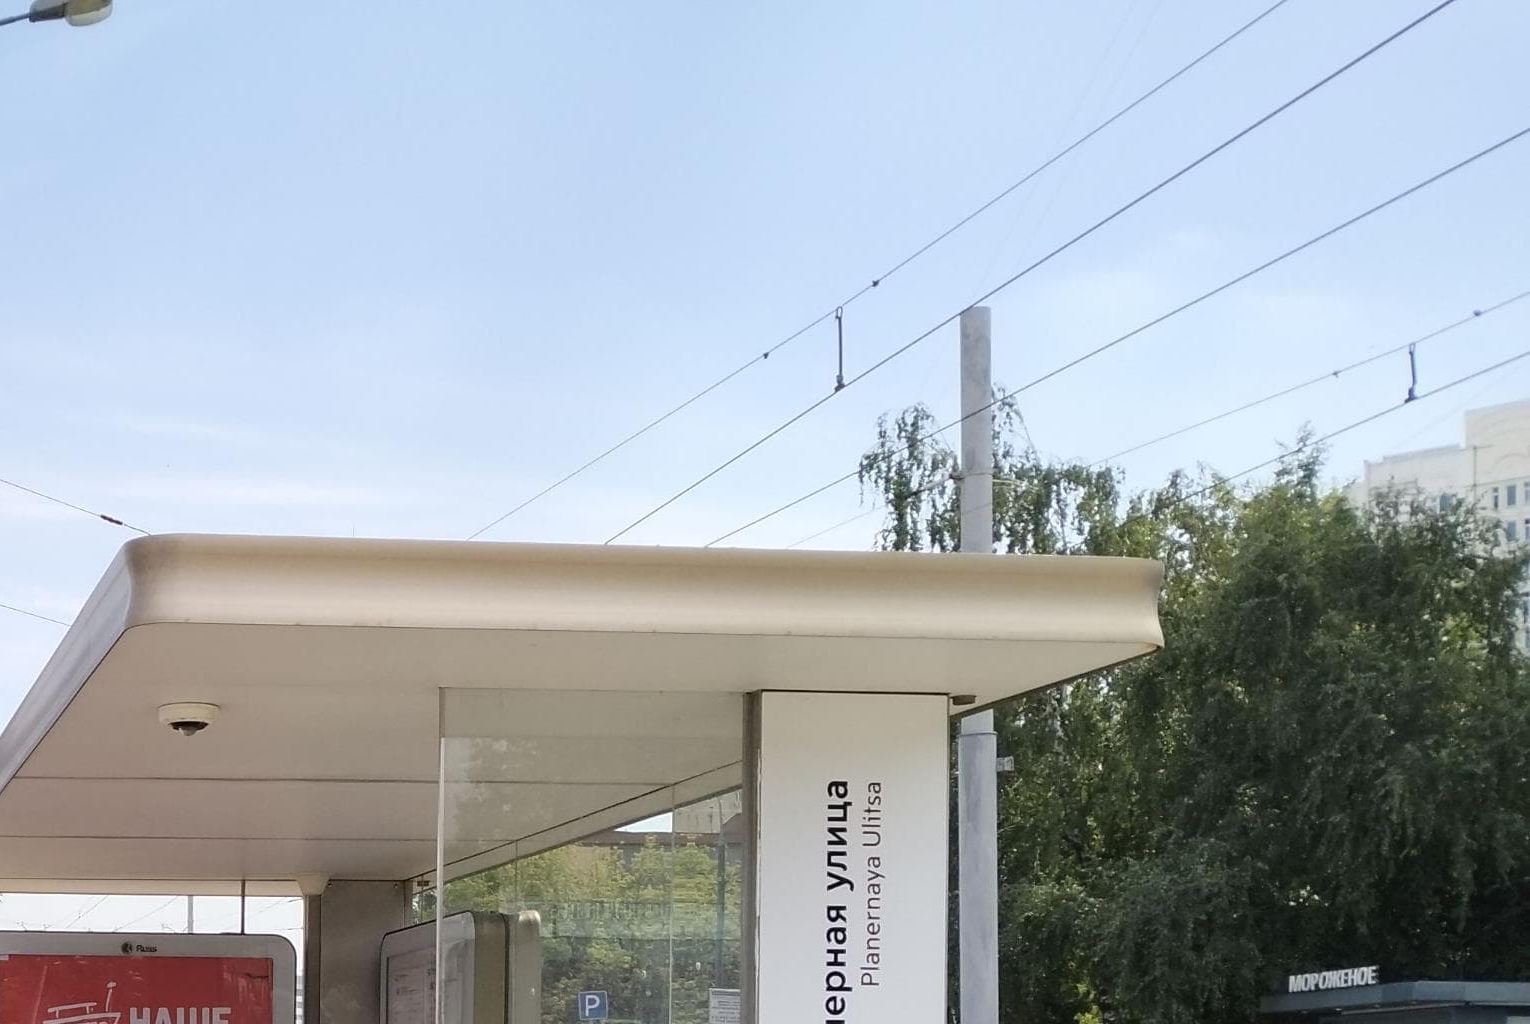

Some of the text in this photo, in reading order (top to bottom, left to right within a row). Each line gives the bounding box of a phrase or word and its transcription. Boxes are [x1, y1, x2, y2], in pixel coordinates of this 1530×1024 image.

[827, 779, 854, 892] улица
[860, 781, 885, 986] Planernaya Ulitsa
[585, 994, 600, 1017] P
[1288, 965, 1379, 992] МОРОЖЕНОЕ
